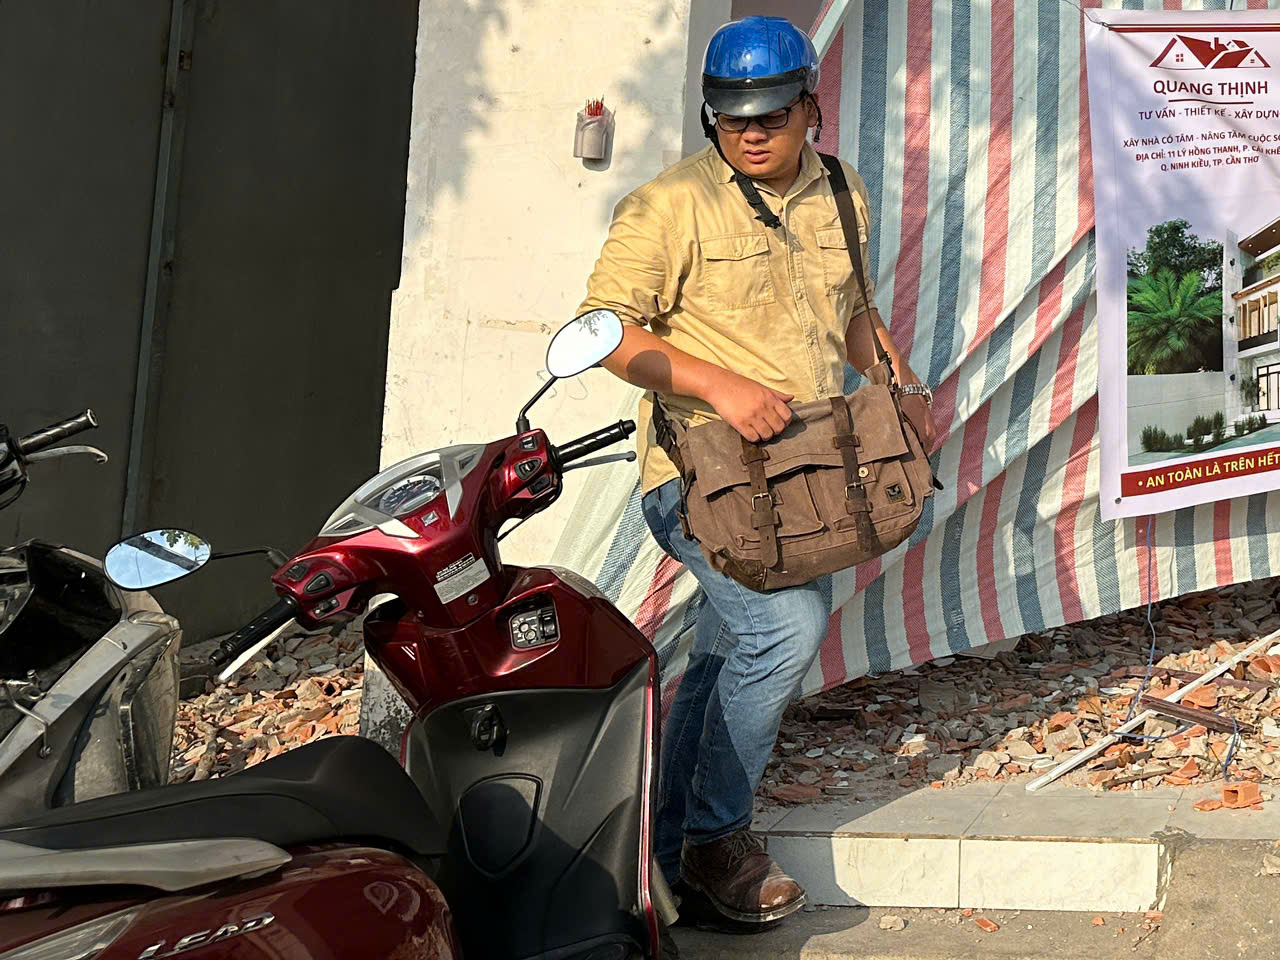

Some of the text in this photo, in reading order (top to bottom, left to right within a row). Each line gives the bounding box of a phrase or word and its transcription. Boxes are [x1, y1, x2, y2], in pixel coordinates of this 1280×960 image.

[1153, 79, 1268, 98] QUANG THỊNH
[1138, 110, 1153, 120] TƯ
[1234, 108, 1253, 119] XÂY
[1167, 150, 1176, 158] 11
[1146, 474, 1165, 488] AN
[1168, 465, 1203, 483] TOÀN
[1205, 460, 1221, 476] LÀ
[1224, 457, 1255, 473] TRÊN
[1258, 450, 1280, 467] HẾT
